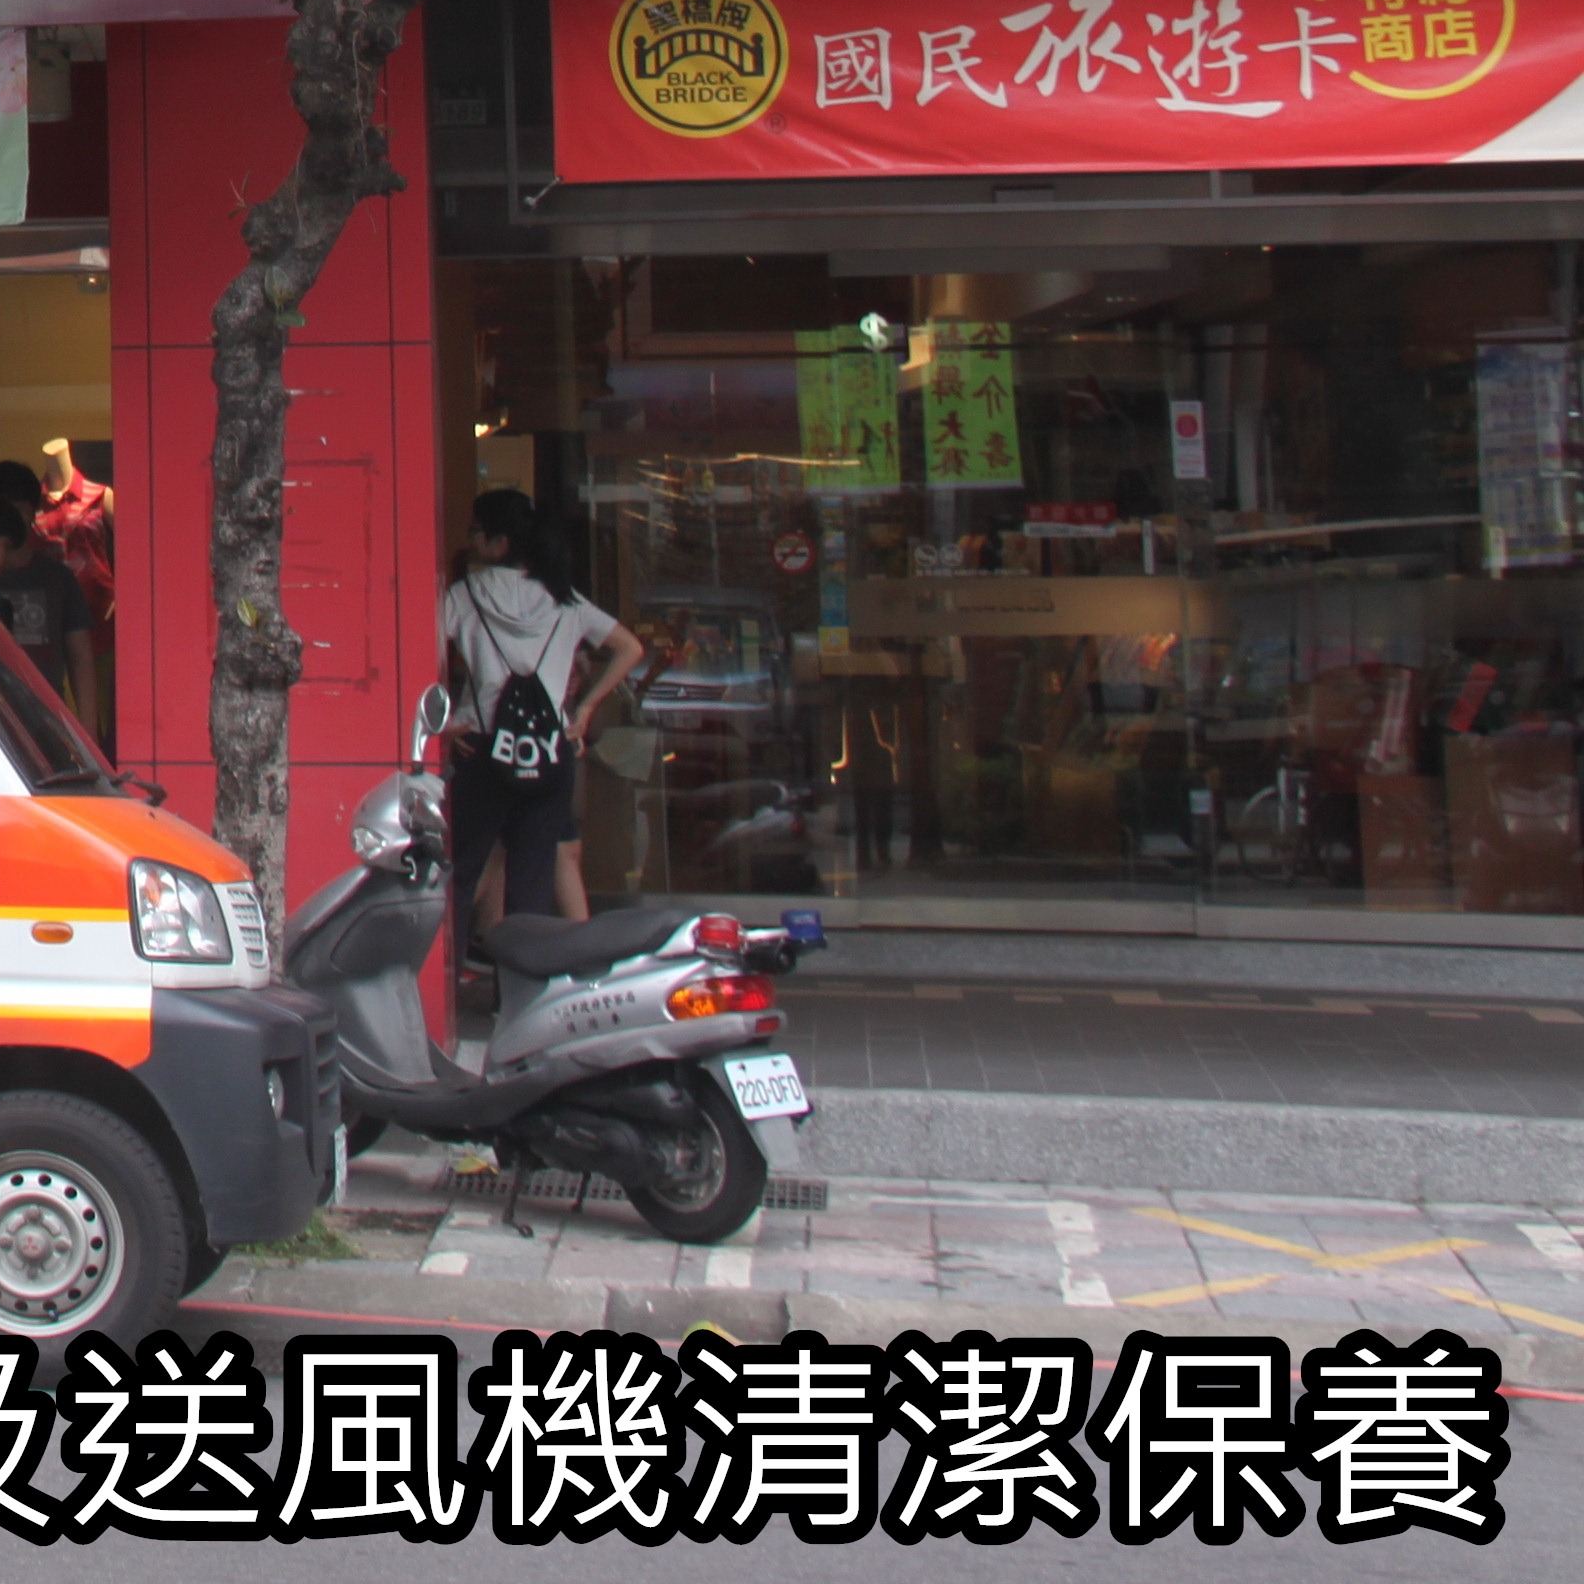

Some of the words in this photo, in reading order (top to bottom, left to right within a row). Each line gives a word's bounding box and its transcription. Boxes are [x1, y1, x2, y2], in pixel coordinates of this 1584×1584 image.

[1360, 8, 1478, 63] 商店
[667, 71, 736, 86] BLACK
[655, 87, 748, 104] BRIDGE
[491, 727, 560, 768] BOY
